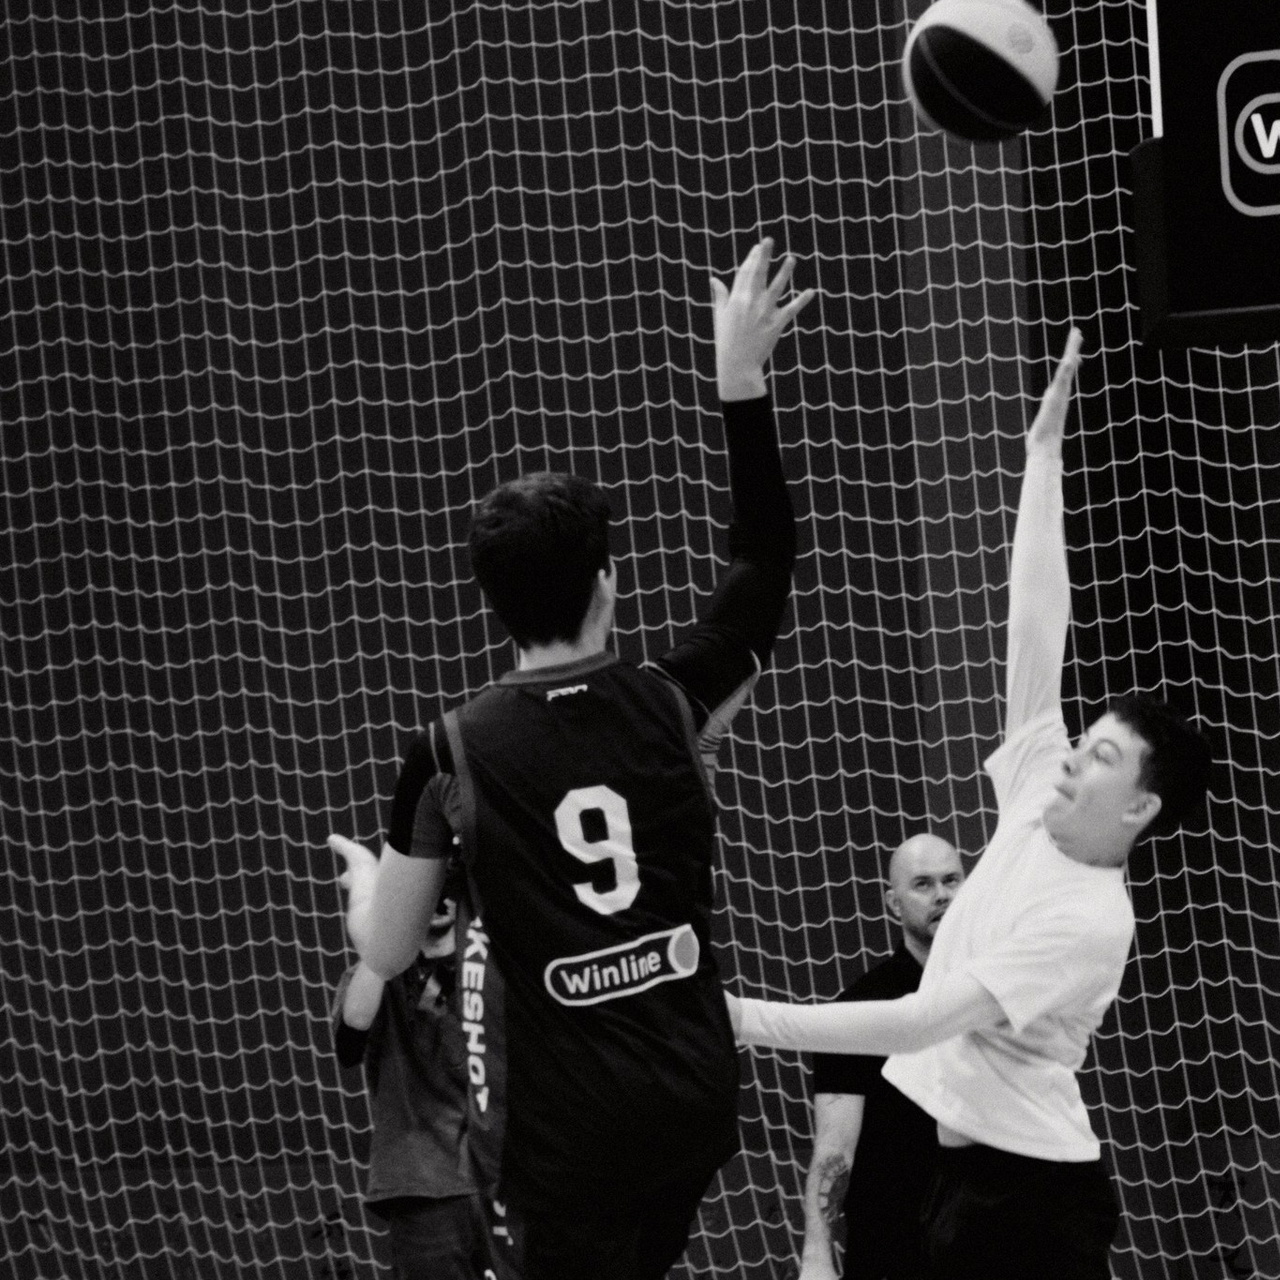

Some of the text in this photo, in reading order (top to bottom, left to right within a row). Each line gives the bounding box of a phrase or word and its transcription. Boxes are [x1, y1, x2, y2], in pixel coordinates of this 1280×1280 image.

[553, 784, 642, 915] 9
[461, 915, 491, 1113] KESHOT
[560, 950, 662, 995] Winline
